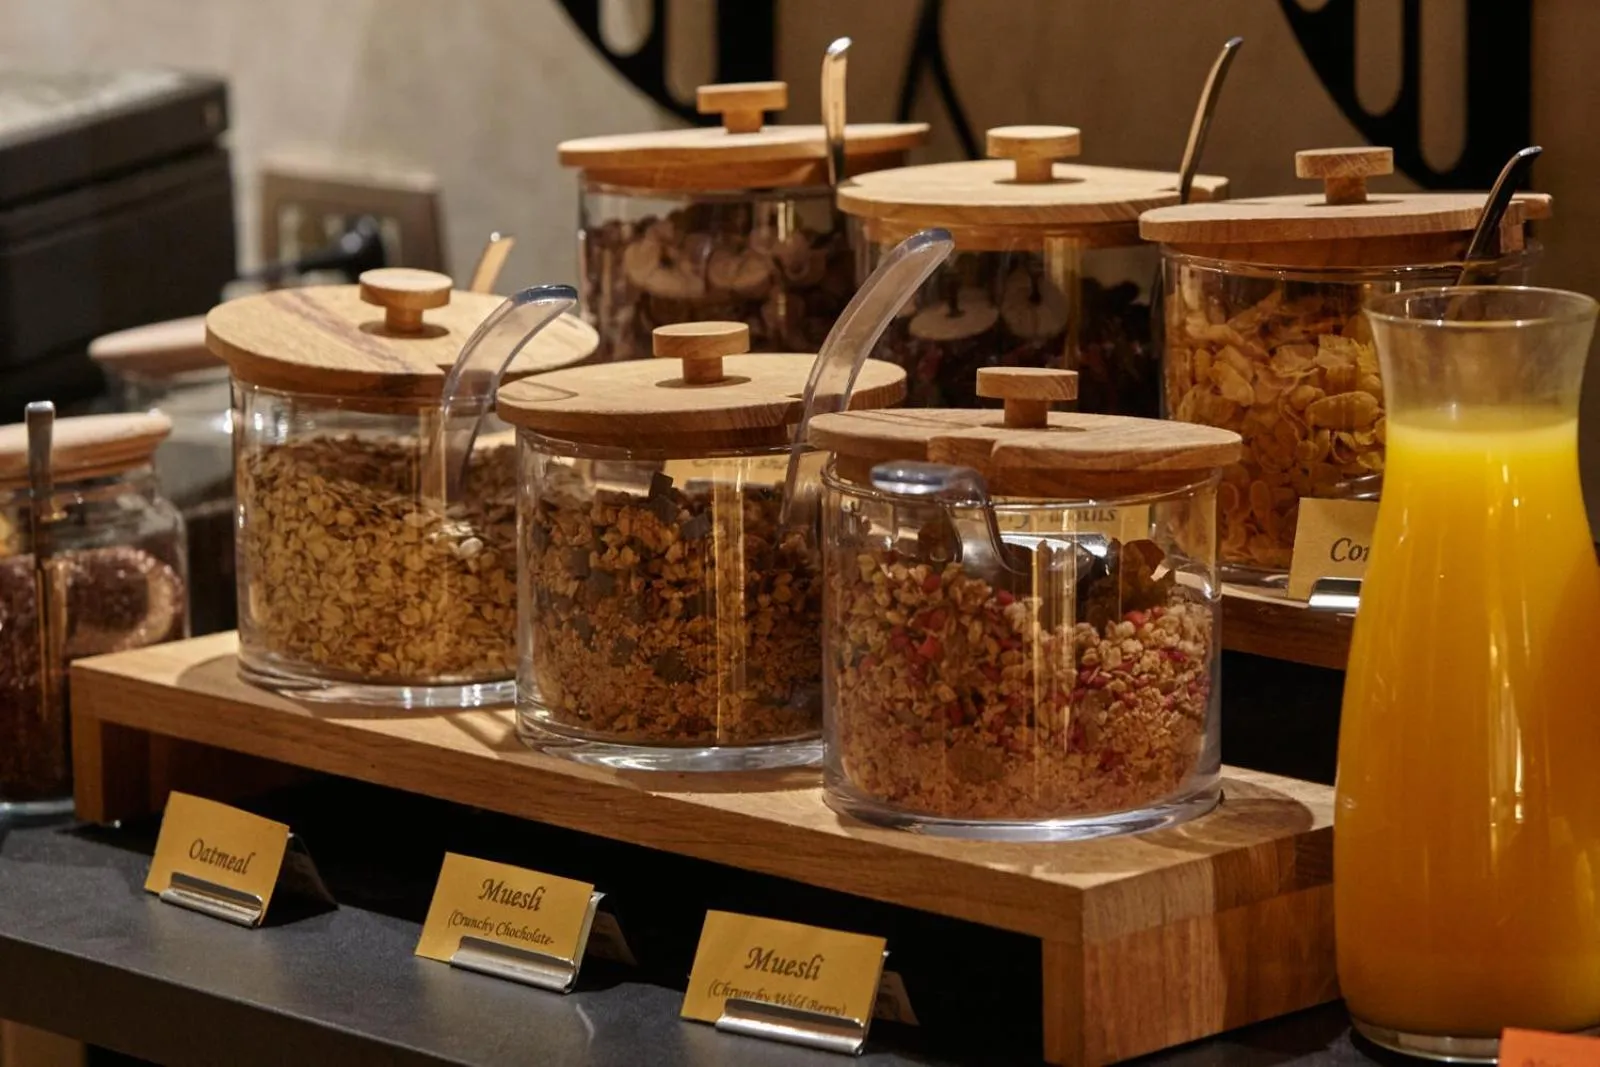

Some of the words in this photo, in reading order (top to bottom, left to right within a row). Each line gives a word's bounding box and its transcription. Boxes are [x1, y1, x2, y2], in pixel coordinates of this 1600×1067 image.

[188, 837, 256, 875] Oatmeal
[478, 878, 546, 911] Muesli
[448, 909, 495, 936] (Crunchy
[745, 947, 825, 981] Muesli
